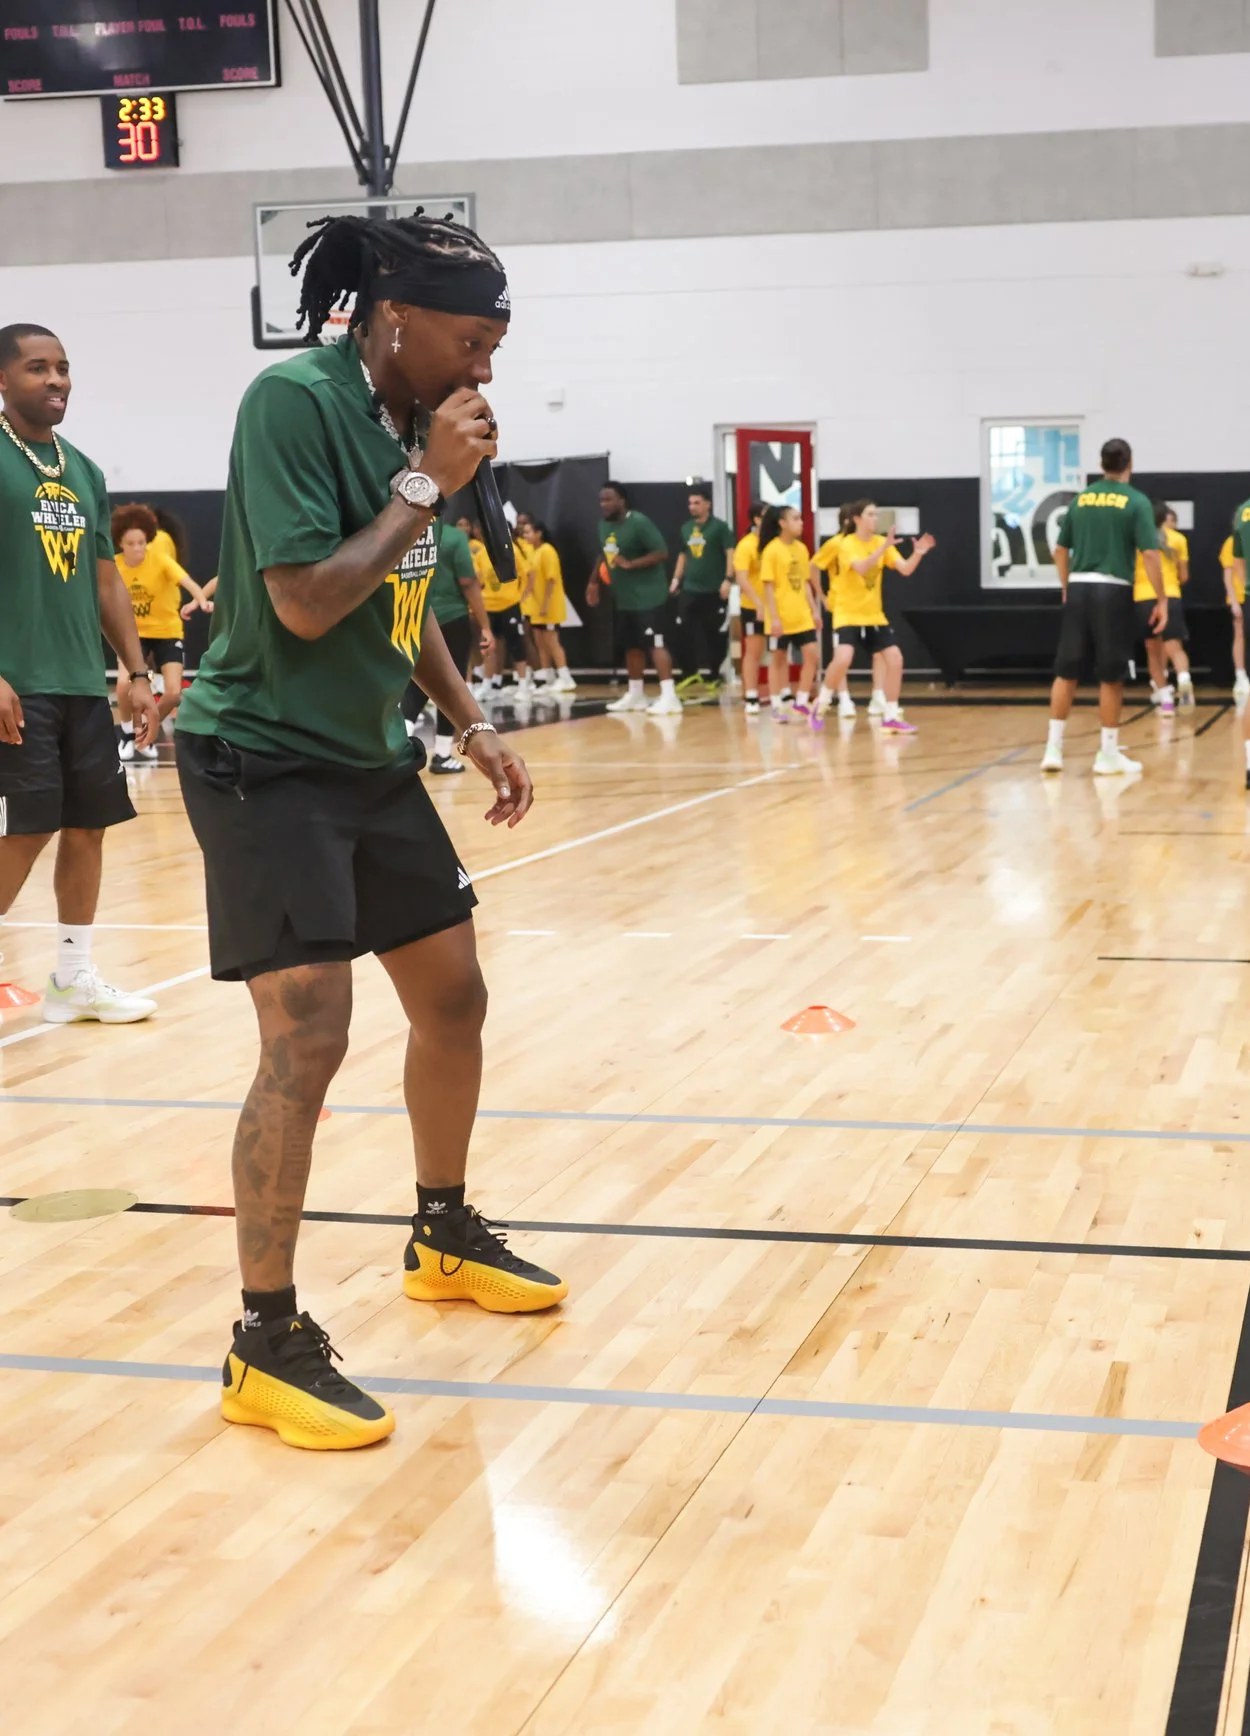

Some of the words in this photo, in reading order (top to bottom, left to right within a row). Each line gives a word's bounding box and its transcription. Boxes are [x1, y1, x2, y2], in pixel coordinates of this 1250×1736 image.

[95, 21, 134, 36] PLAYER
[138, 19, 166, 33] FOUL
[220, 14, 256, 28] FOULS
[113, 73, 150, 87] MATCH
[223, 67, 259, 81] SCORE
[8, 79, 43, 93] SCORE
[119, 97, 166, 122] 2:33
[117, 121, 159, 162] 30
[1077, 492, 1129, 509] COACH
